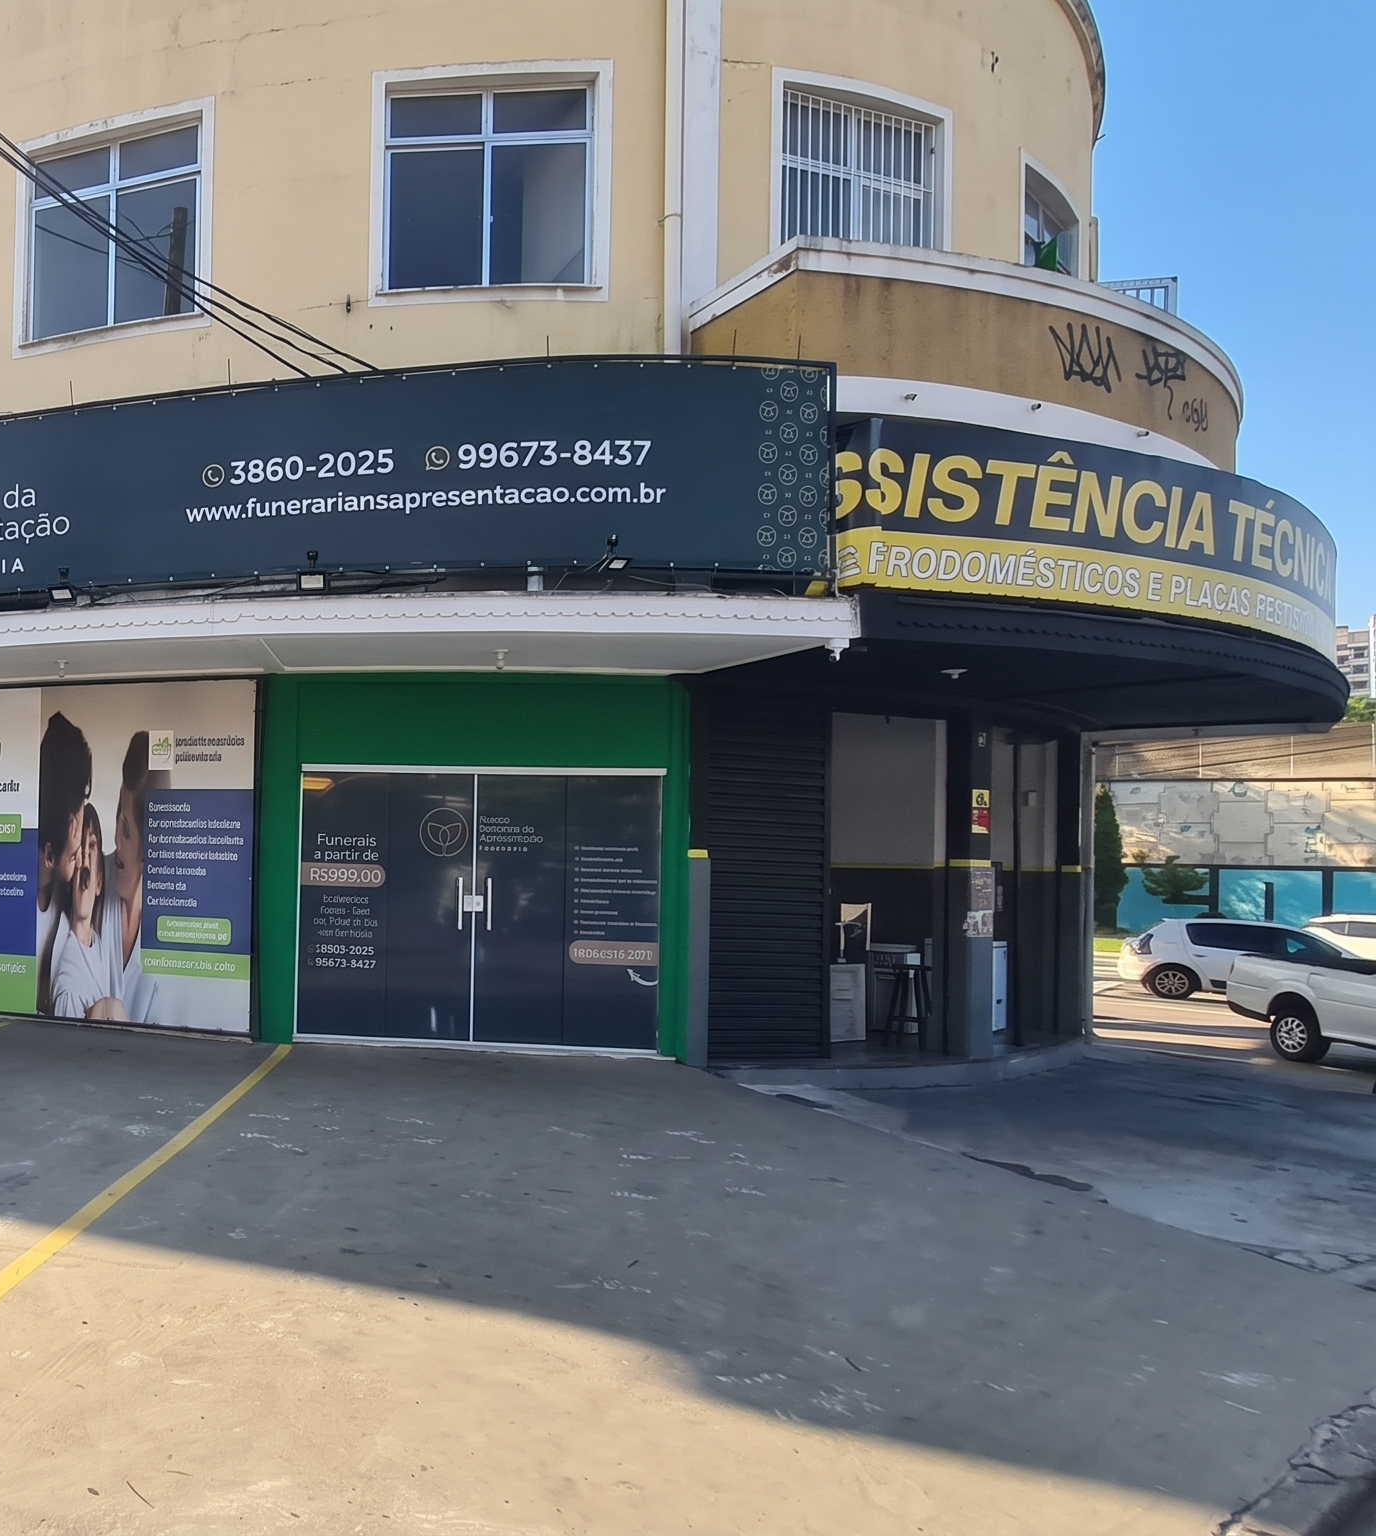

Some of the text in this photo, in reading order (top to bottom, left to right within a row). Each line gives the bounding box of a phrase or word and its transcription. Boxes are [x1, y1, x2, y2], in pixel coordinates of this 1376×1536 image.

[229, 440, 652, 485] 3860-2025 99673-8437
[3, 483, 36, 509] da
[185, 482, 667, 523] www.funerariansapresentacao.com.br
[1147, 571, 1163, 601] E
[317, 833, 377, 847] Funerais
[314, 849, 379, 861] a partir de
